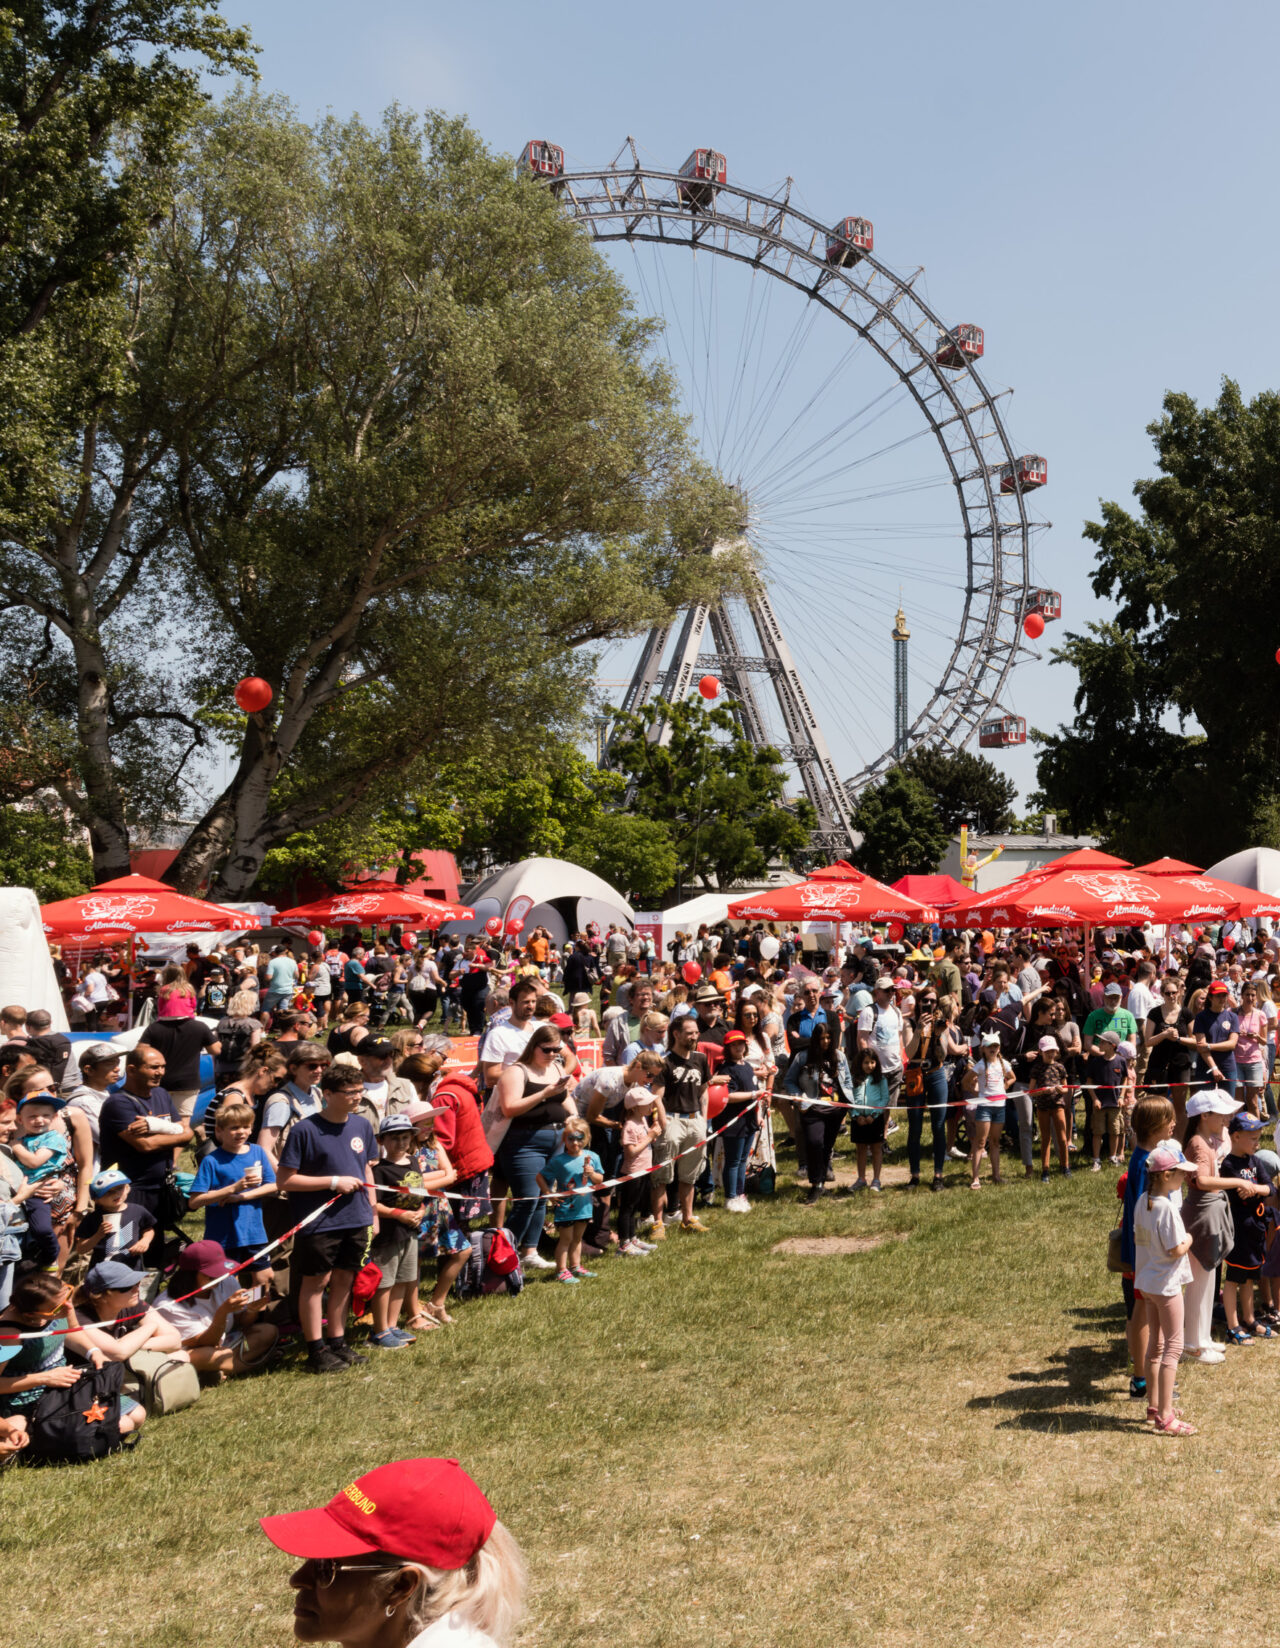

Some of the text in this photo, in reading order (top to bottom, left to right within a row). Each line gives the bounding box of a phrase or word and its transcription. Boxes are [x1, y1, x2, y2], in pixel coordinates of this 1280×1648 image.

[736, 905, 780, 918] Almdudler
[803, 908, 846, 920] Almdudler
[869, 909, 912, 921] Almdudler
[1026, 904, 1078, 918] Almdudler
[1106, 903, 1157, 918] Almdudler
[1183, 903, 1228, 917] Almdudler
[84, 920, 137, 932] Almdudler
[166, 920, 217, 931] Almdudler
[343, 1483, 377, 1515] TERBUND
